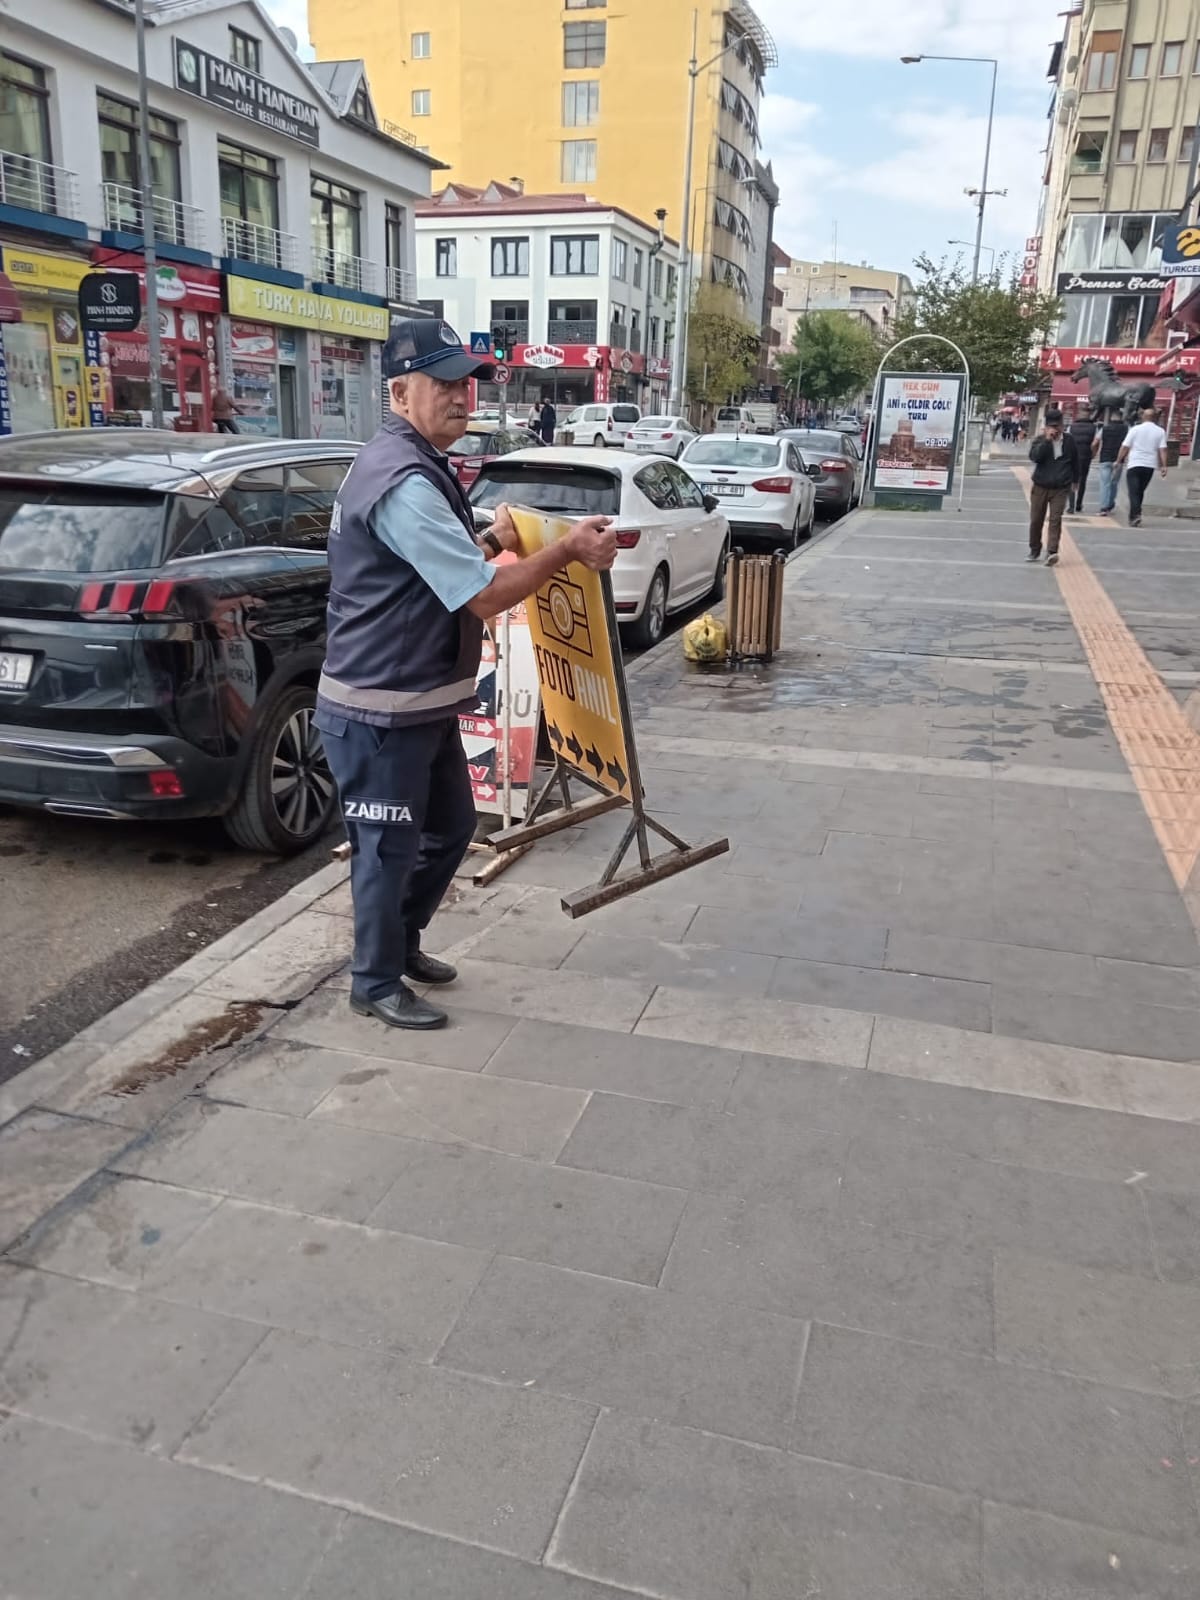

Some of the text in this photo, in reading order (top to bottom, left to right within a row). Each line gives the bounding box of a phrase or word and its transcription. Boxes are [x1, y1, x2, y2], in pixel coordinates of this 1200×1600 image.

[235, 99, 299, 137] CAFE RESTAURANT
[1064, 277, 1125, 291] Prenses
[253, 287, 385, 331] TÜRK HAVA YOLLARI
[1115, 353, 1142, 366] MİNİ
[1144, 354, 1197, 366] MET
[908, 412, 928, 421] TURU
[536, 643, 576, 702] FOTO
[344, 801, 413, 822] ZABITA
